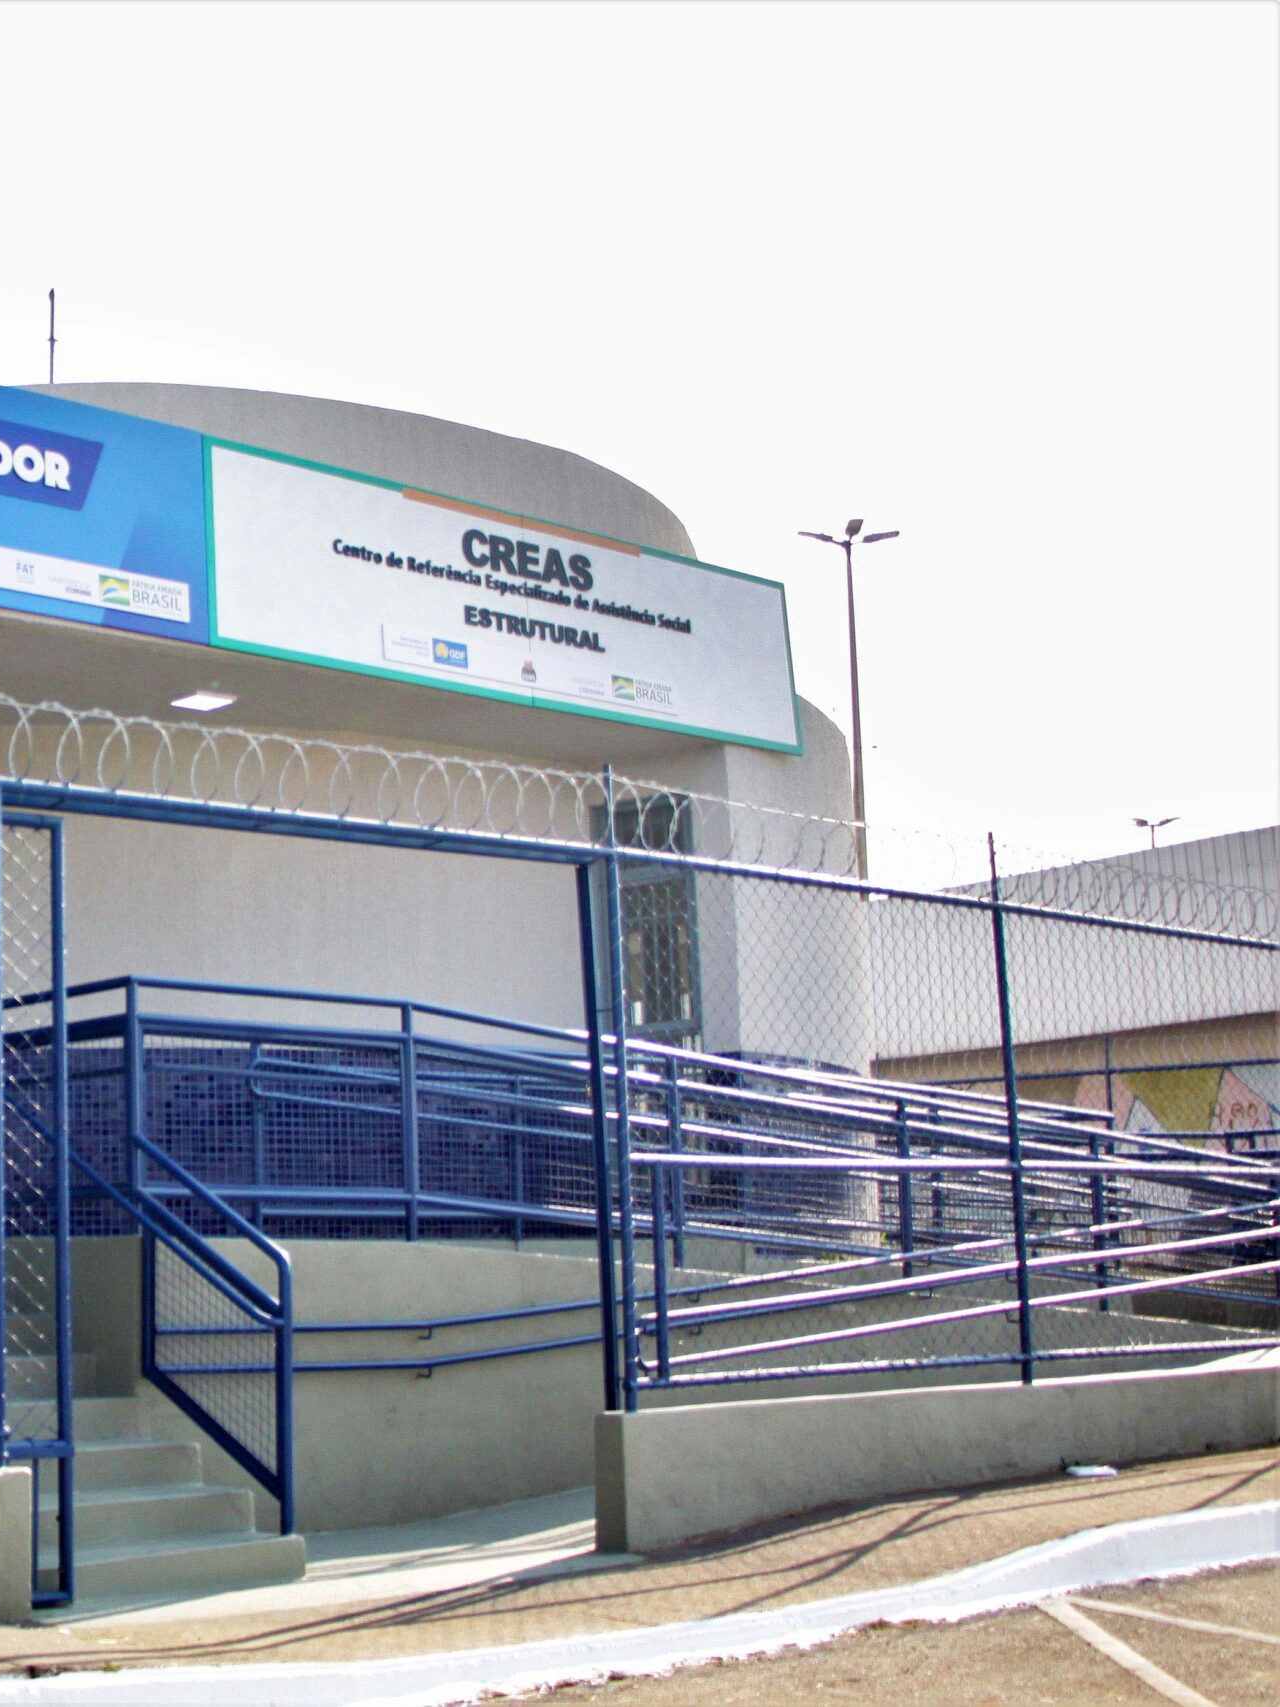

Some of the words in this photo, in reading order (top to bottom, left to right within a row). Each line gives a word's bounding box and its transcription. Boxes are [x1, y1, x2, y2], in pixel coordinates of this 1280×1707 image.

[15, 562, 35, 575] FAT
[461, 528, 594, 591] CREAS
[132, 589, 183, 612] BRASIL
[332, 538, 382, 564] Centro
[385, 552, 403, 569] de
[407, 556, 481, 586] Referência
[485, 574, 571, 606] Especializado
[573, 593, 589, 611] de
[592, 598, 656, 626] Assistência
[657, 613, 691, 634] Social
[463, 604, 605, 652] ESTRUTURAL
[635, 686, 673, 705] BRASIL
